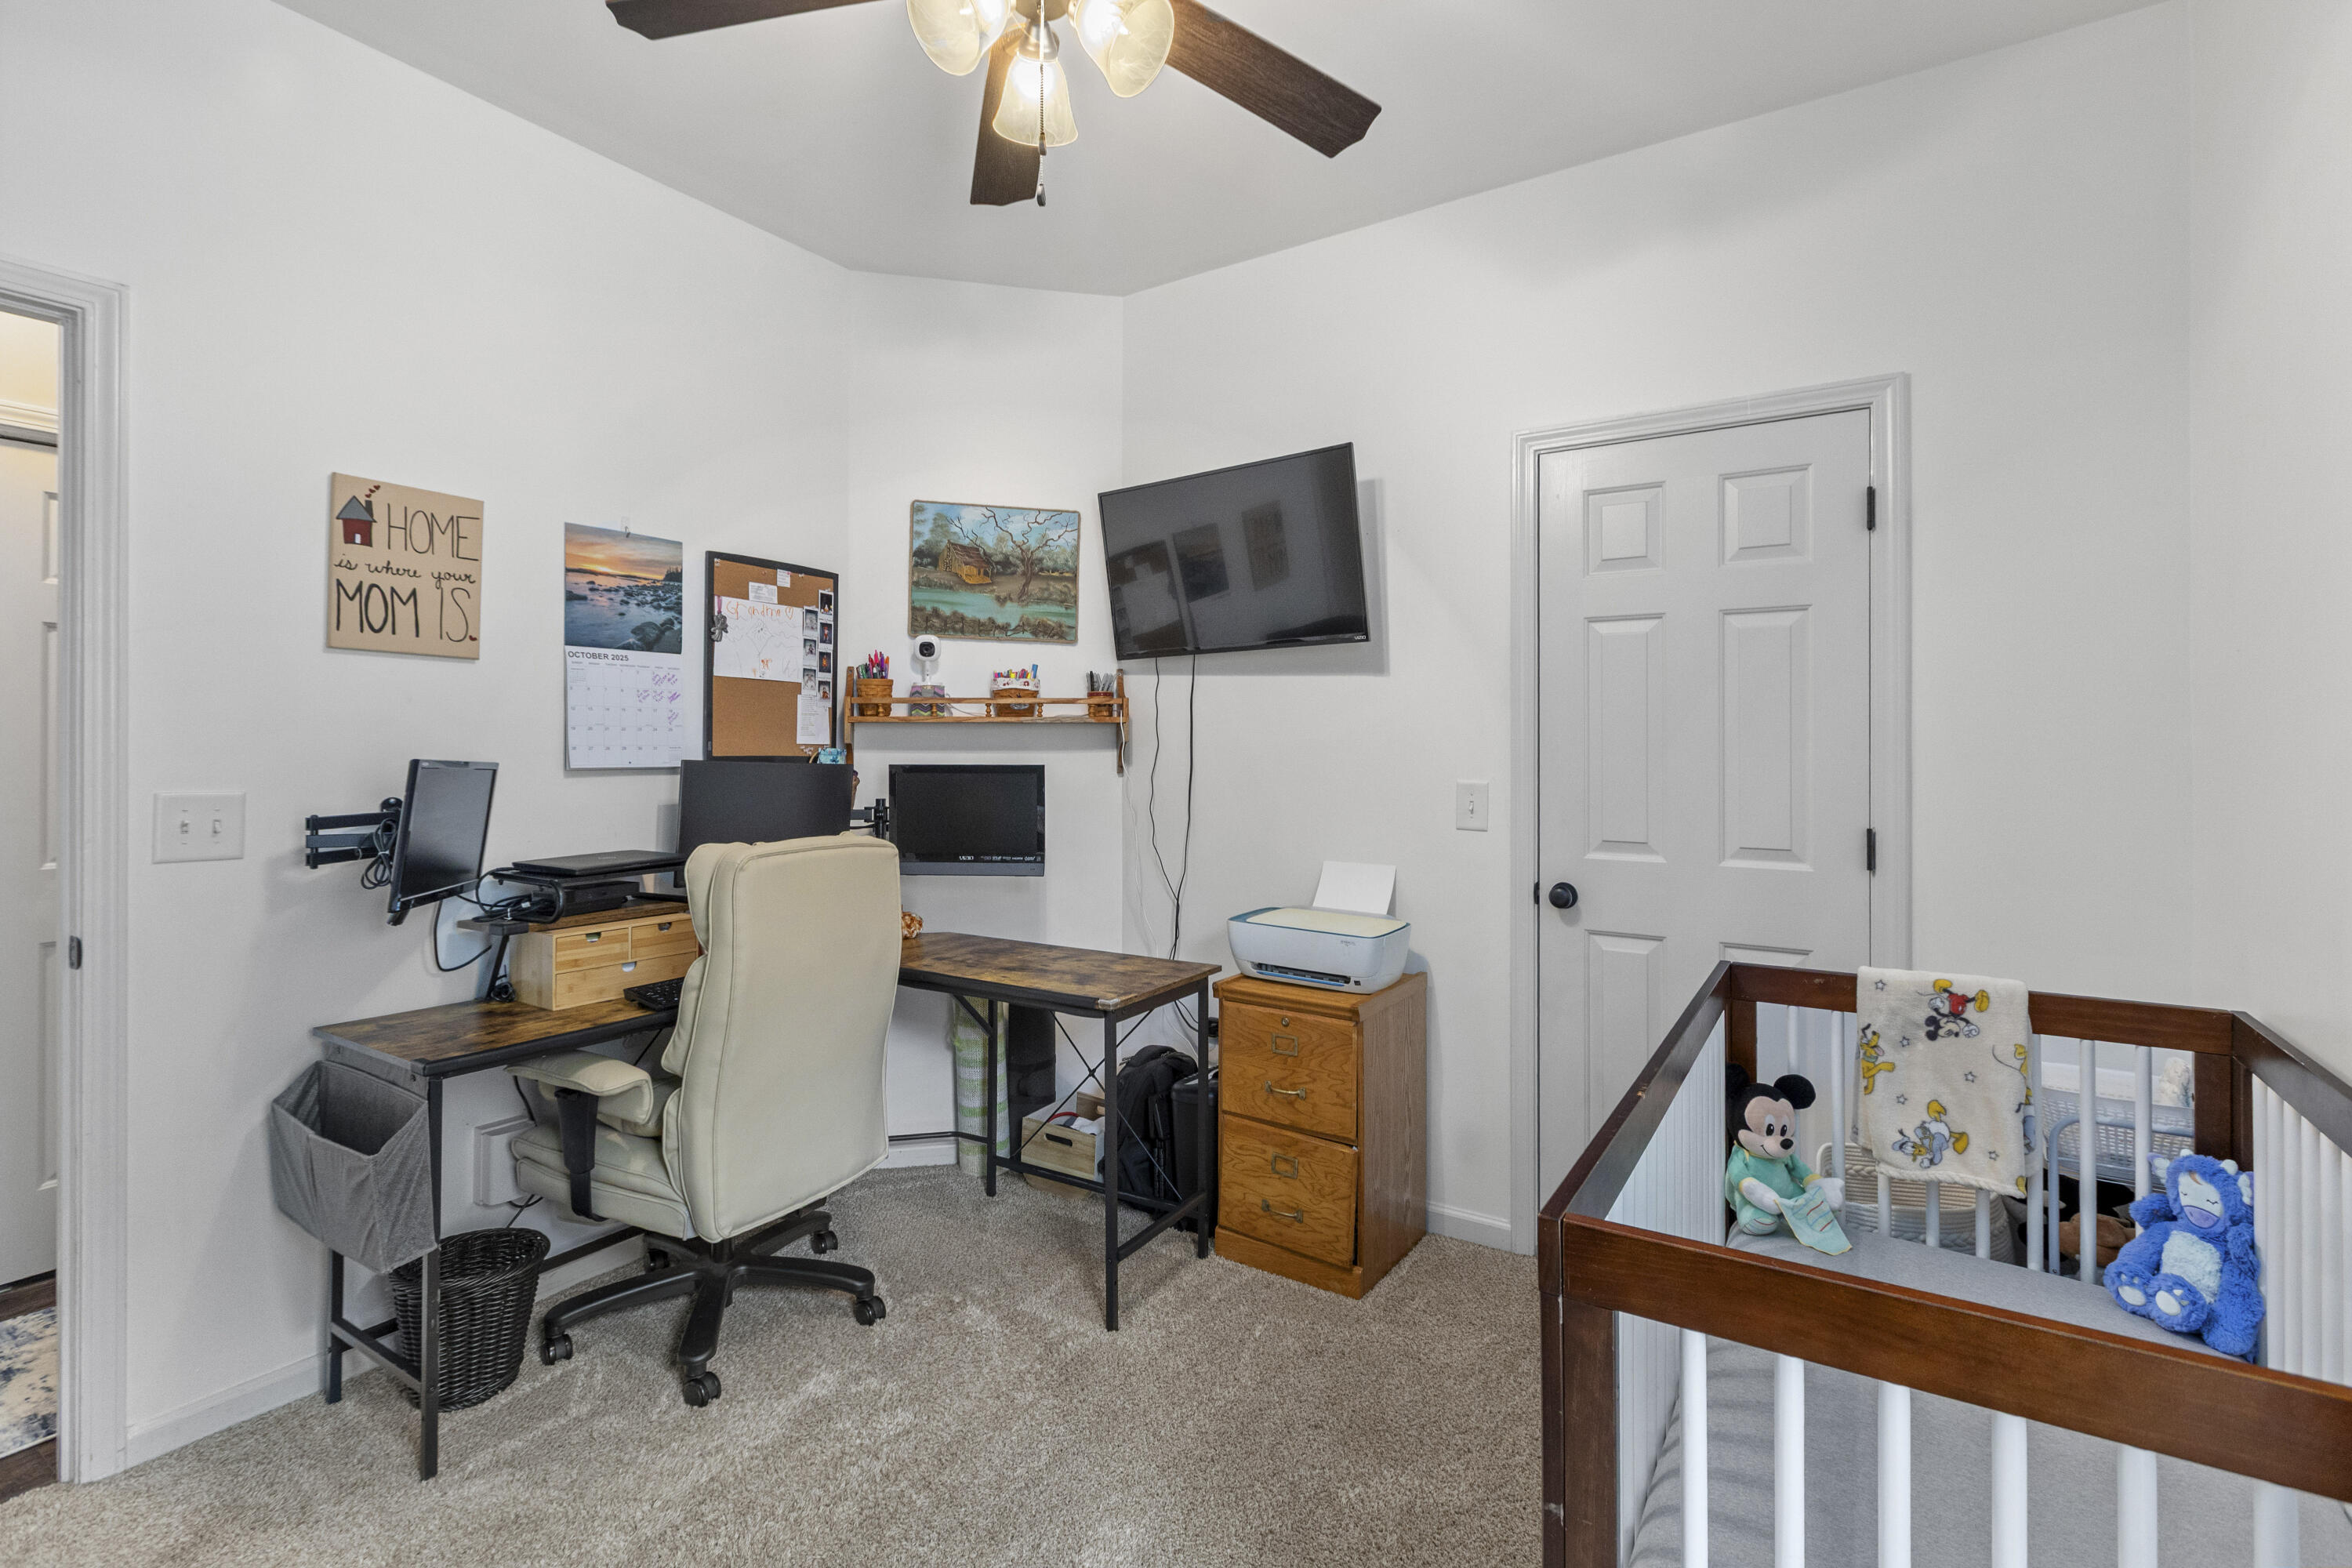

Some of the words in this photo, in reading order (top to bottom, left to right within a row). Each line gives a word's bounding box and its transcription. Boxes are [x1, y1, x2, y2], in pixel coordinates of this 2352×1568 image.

[387, 503, 481, 561] HOME
[334, 554, 358, 570] is
[365, 561, 422, 578] where
[431, 571, 476, 590] your
[336, 579, 419, 637] MOM
[439, 587, 470, 642] IS
[568, 651, 609, 660] OCTOBER
